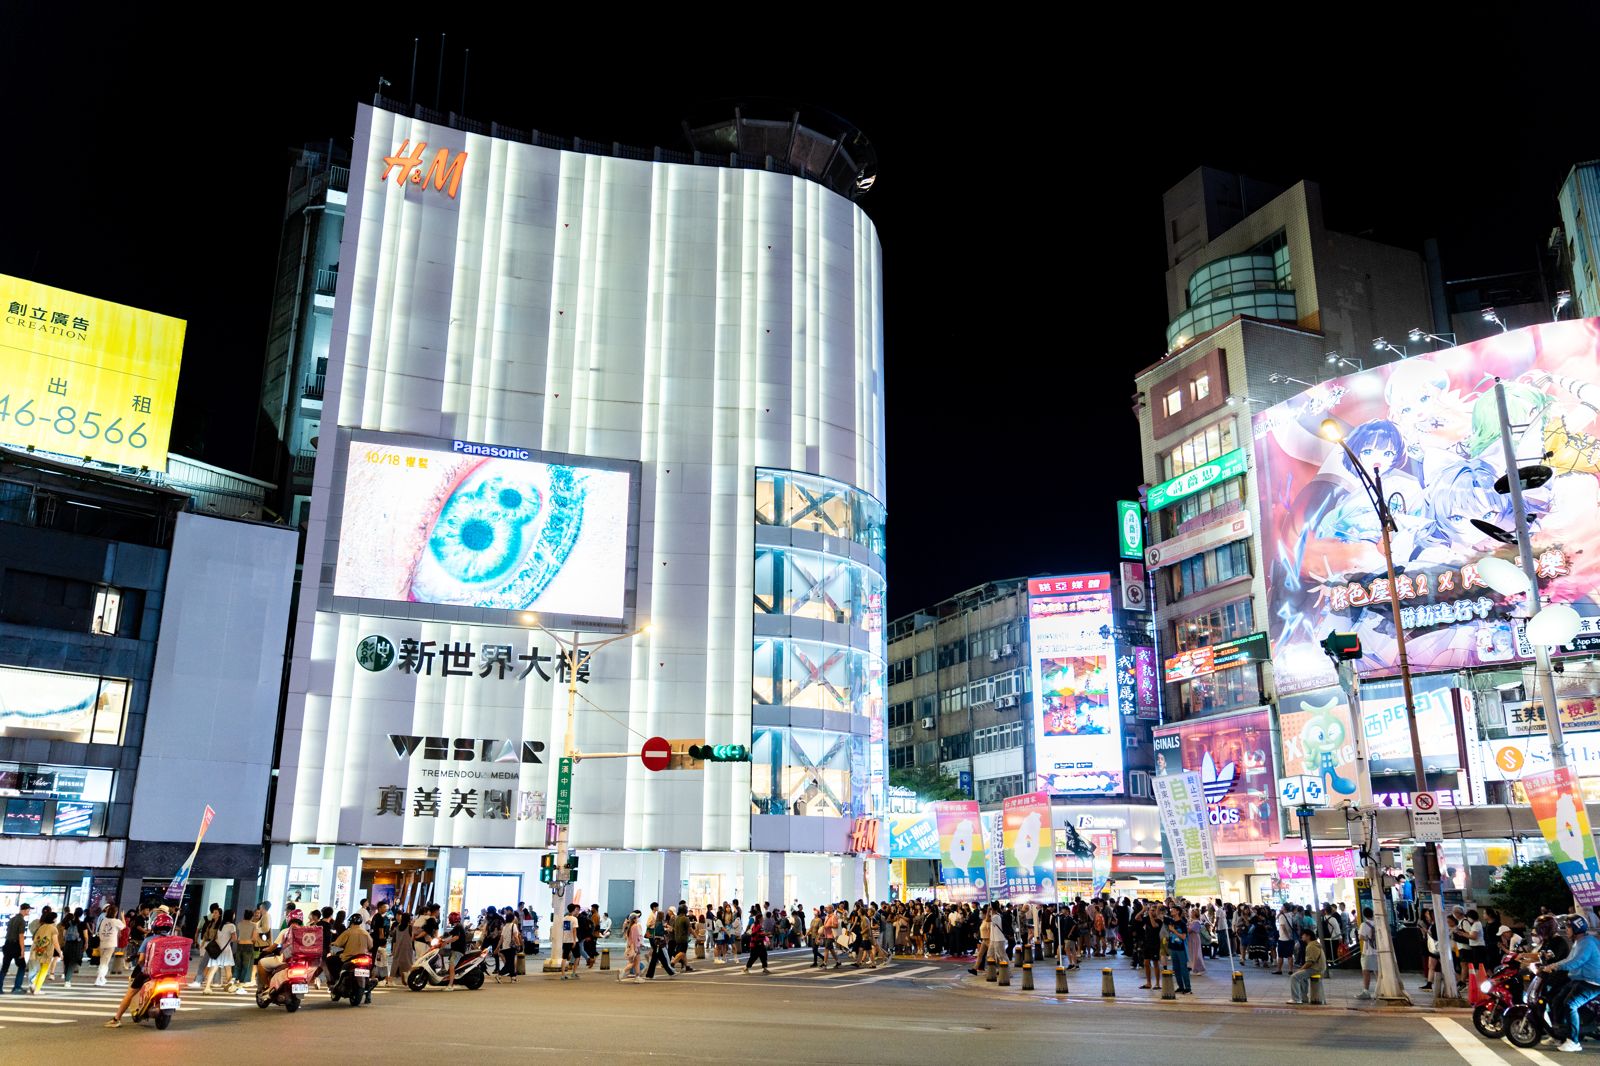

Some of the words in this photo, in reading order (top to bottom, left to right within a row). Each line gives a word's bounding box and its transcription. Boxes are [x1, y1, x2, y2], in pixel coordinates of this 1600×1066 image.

[381, 138, 468, 199] H&M
[5, 315, 88, 341] CREATION
[8, 301, 90, 332] 創立廣告
[47, 377, 68, 397] 出
[131, 394, 152, 414] 租
[453, 440, 529, 460] Panasonic
[397, 637, 591, 684] 新世界大樓
[491, 771, 519, 779] MEDIA
[560, 765, 569, 797] 漢中街
[1373, 789, 1470, 808] KILER
[850, 818, 879, 852] H&M
